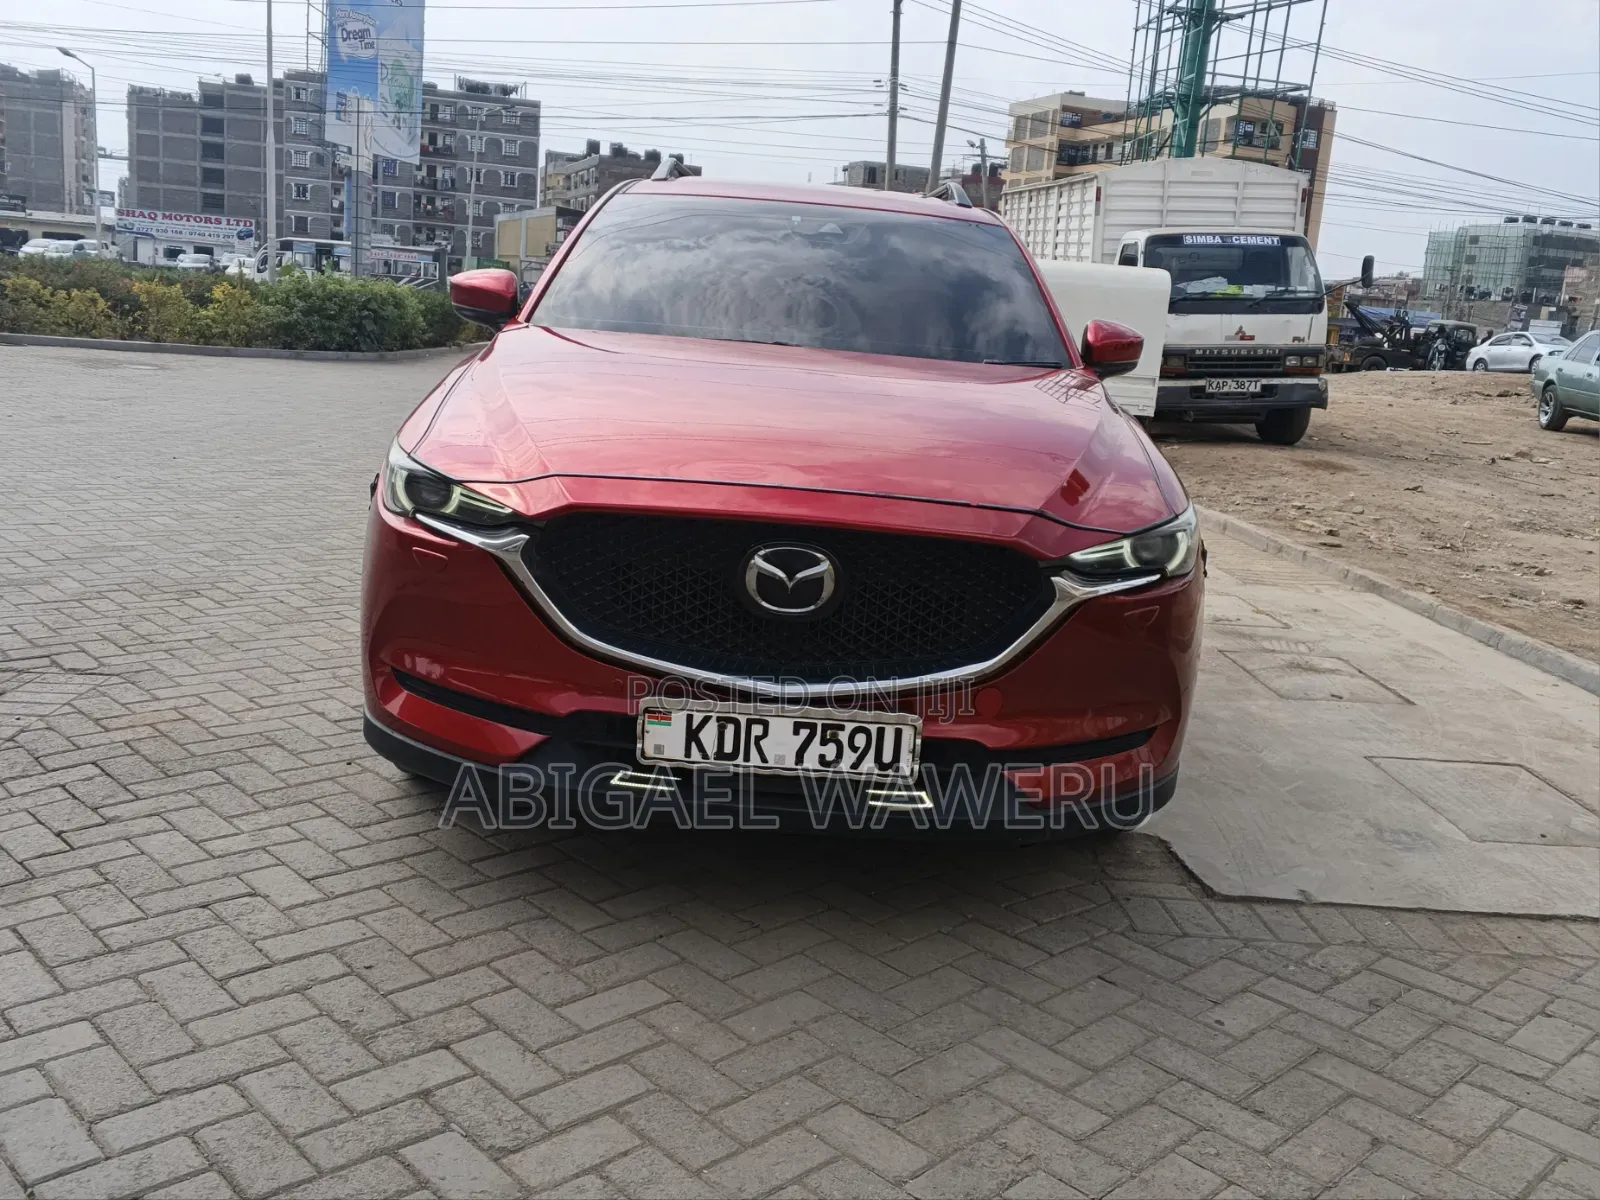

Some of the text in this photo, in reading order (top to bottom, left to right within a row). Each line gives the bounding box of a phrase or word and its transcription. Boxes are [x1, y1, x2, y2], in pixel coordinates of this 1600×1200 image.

[341, 27, 371, 42] Dream
[359, 40, 375, 50] Time
[117, 209, 158, 221] SHAQ
[162, 212, 222, 225] MOTORS
[226, 219, 253, 228] LTD
[1185, 235, 1279, 245] SIMBA CEMENT
[1208, 379, 1260, 391] KAP 387T
[684, 713, 769, 764] KDR
[792, 721, 903, 773] 759U
